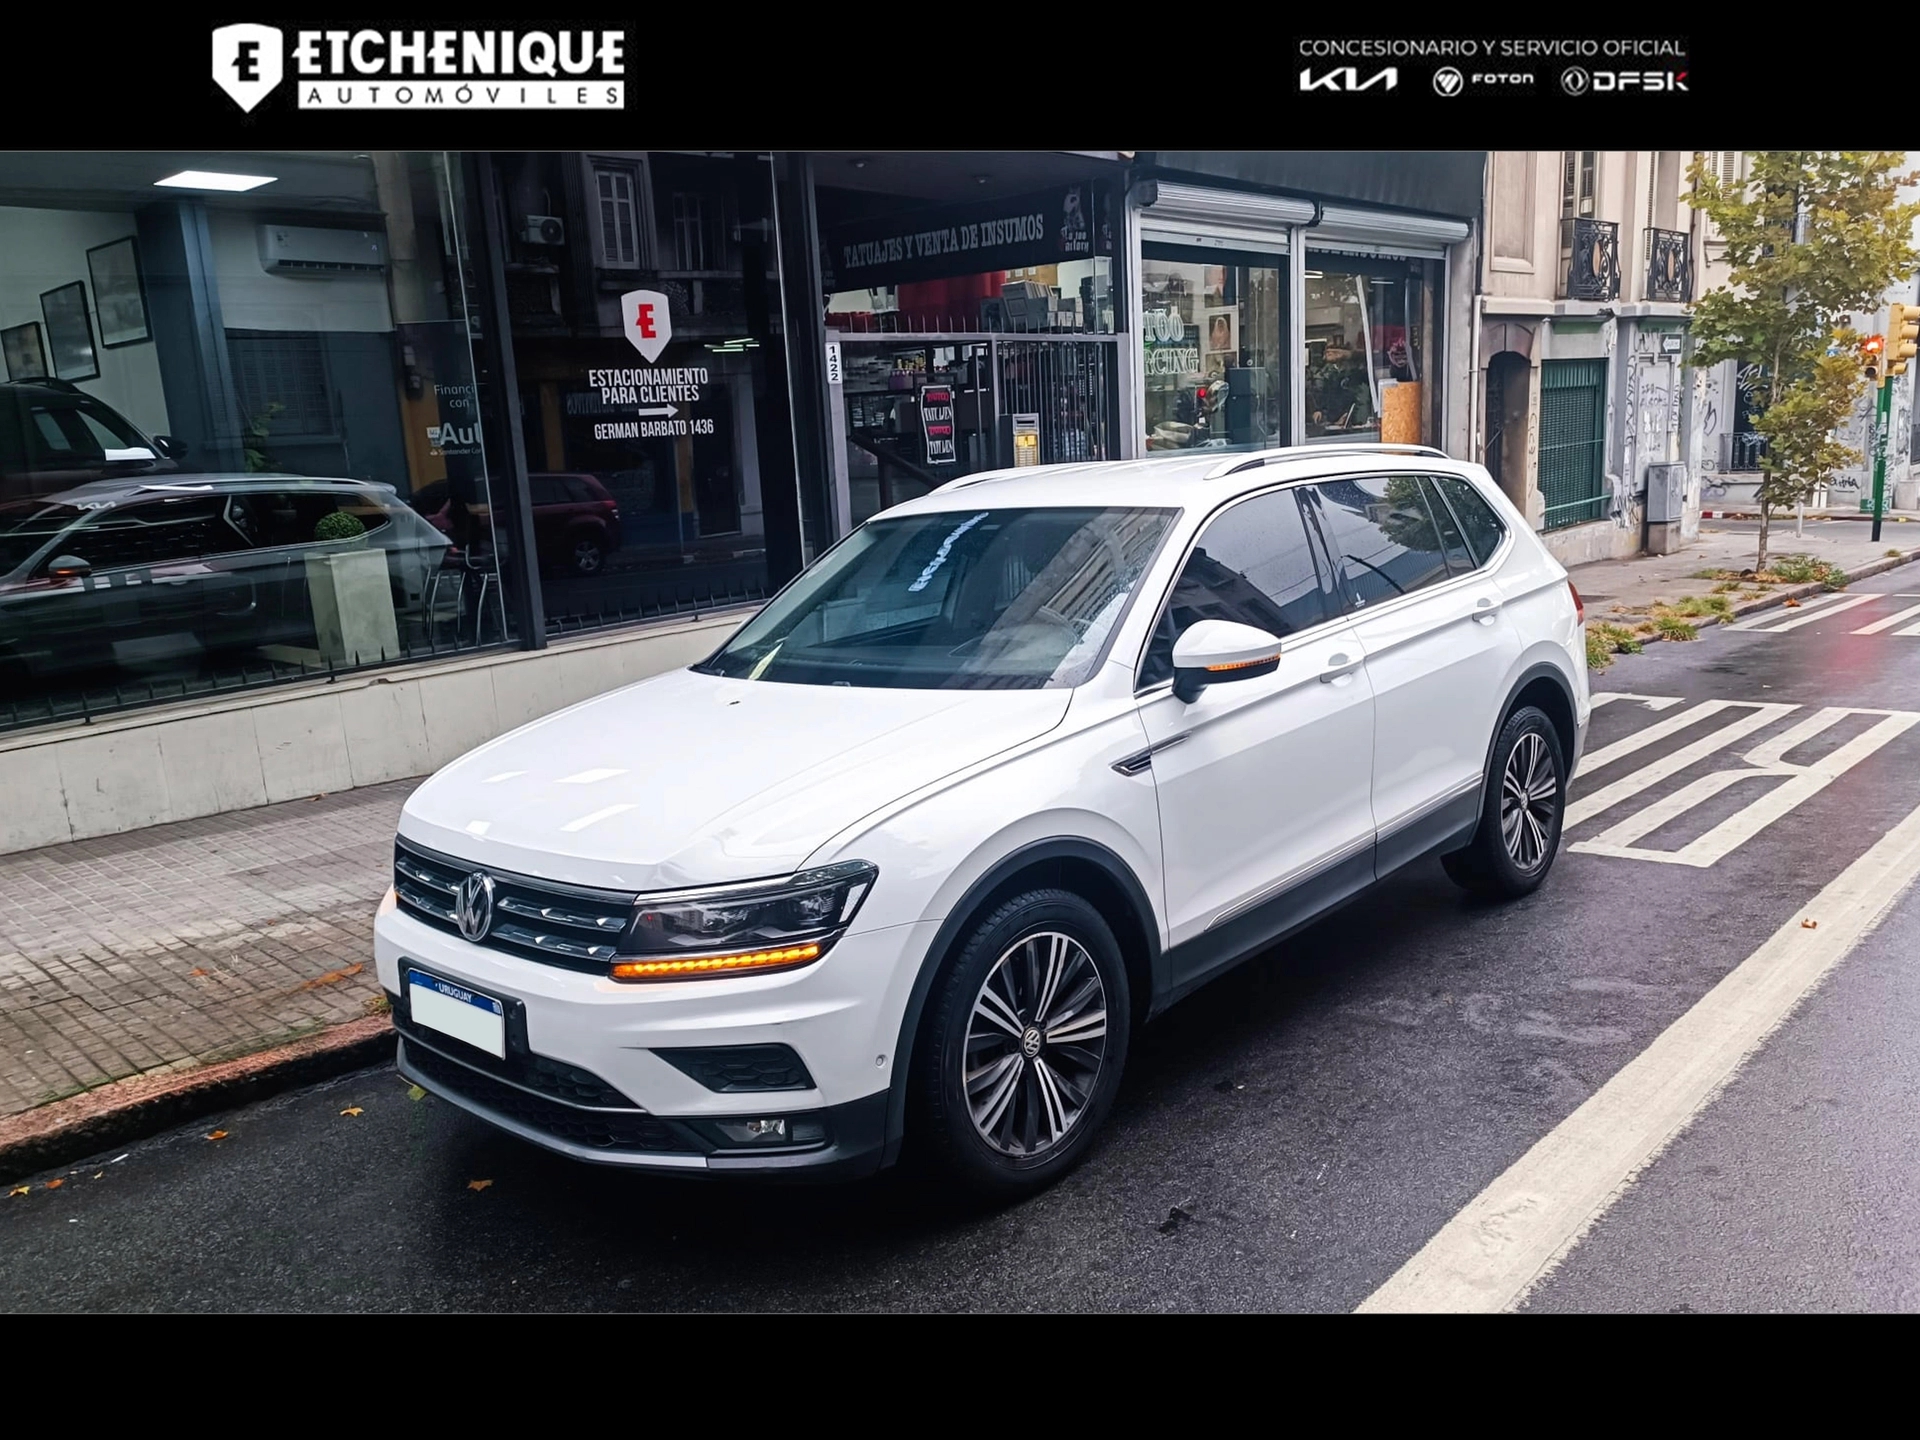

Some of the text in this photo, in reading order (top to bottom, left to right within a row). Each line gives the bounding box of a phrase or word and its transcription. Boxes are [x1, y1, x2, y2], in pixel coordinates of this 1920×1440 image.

[843, 213, 1045, 268] TATUAJES Y VENTA DE INSUMOS
[829, 345, 839, 381] 1422
[588, 367, 709, 387] ESTACIONAMIENTO
[449, 399, 470, 409] con
[602, 386, 637, 404] PARA
[642, 385, 699, 403] CLIENTES
[594, 419, 714, 440] GERMAN BARBATO 1436
[438, 982, 472, 1003] URUGUAY
